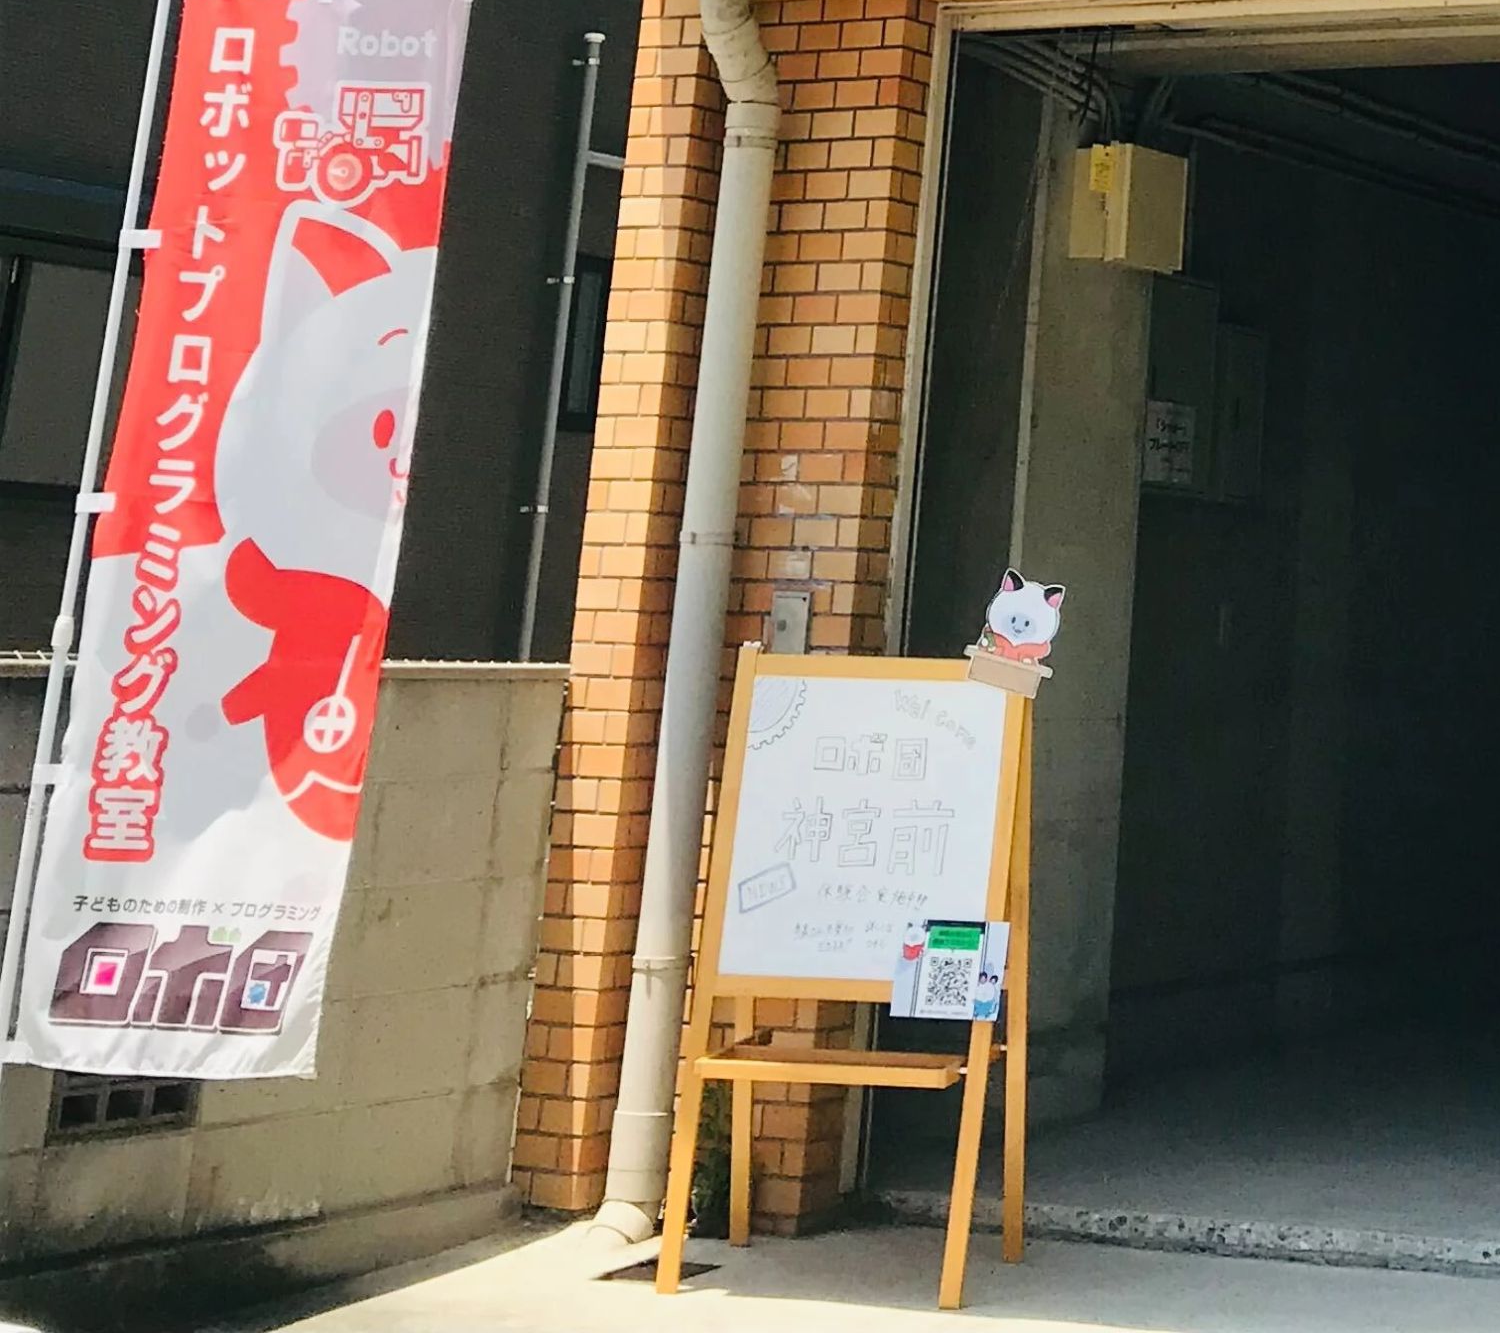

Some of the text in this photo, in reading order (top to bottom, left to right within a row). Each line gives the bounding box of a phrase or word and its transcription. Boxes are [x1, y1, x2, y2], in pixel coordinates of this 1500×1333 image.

[336, 25, 439, 59] Robot
[86, 25, 257, 858] ロボットプログラミング教室
[774, 795, 956, 877] 神宮前
[73, 894, 207, 915] 子どものための制作
[230, 901, 322, 921] プログラミング
